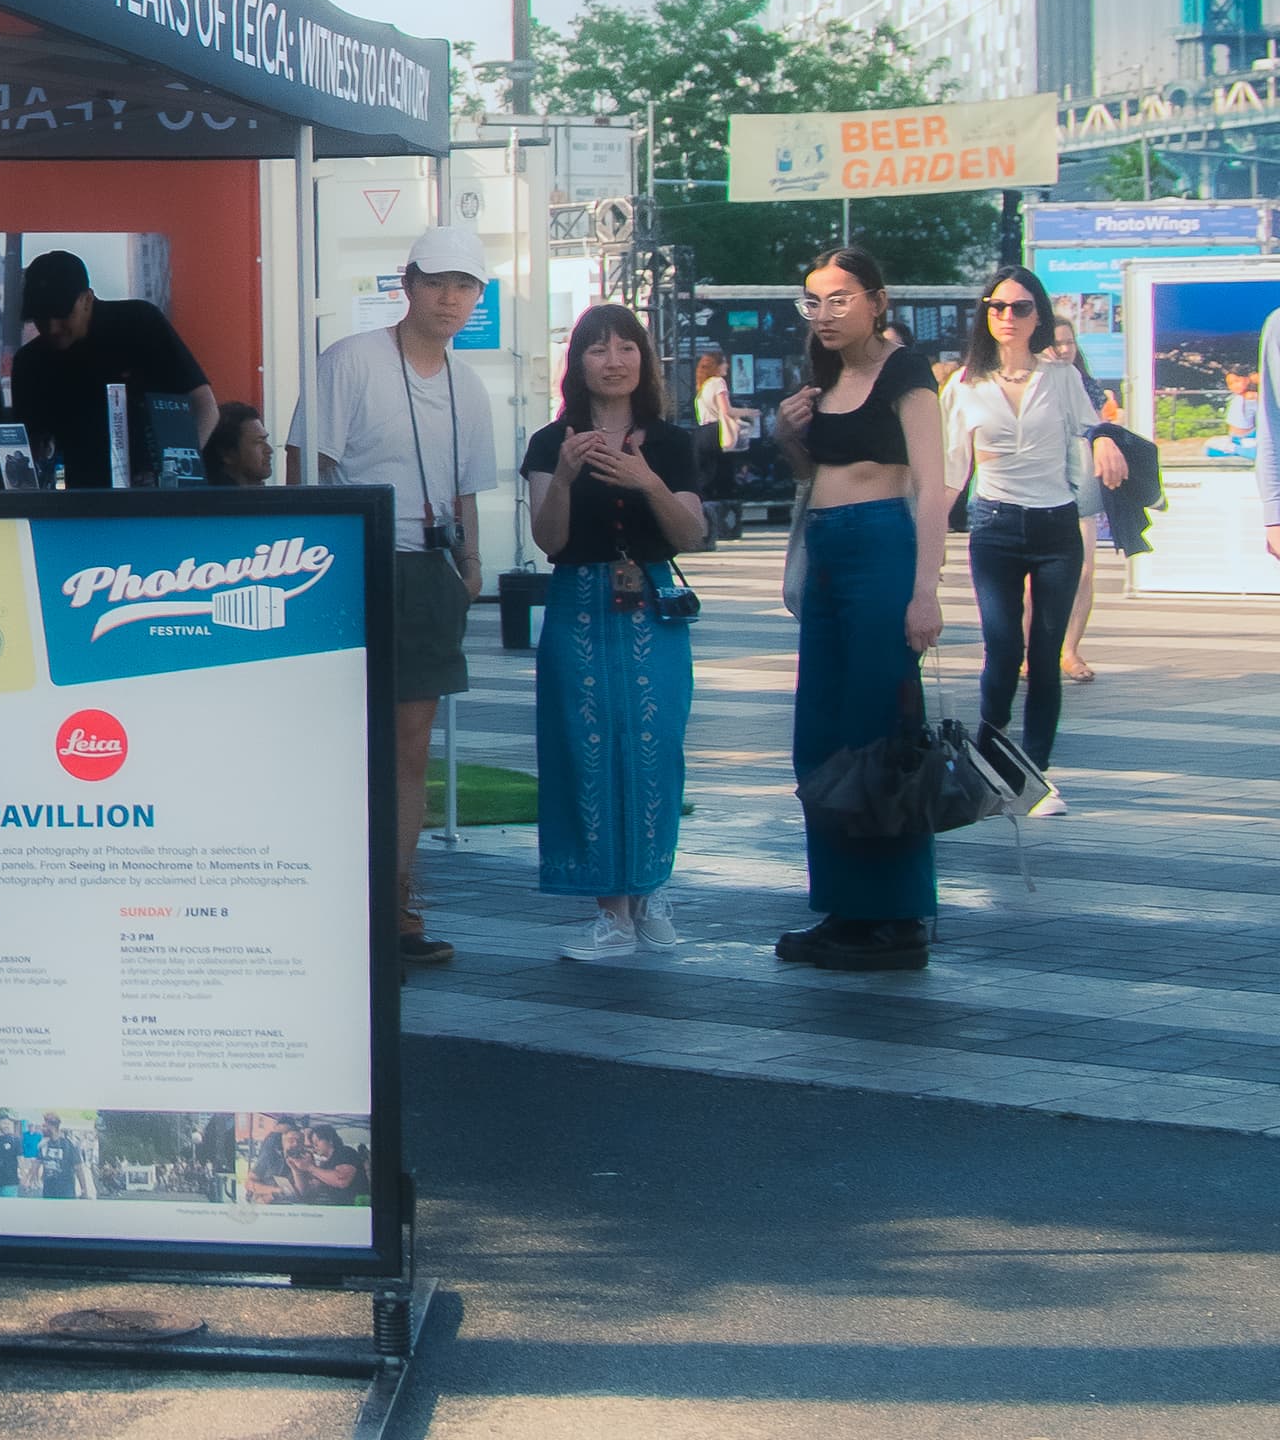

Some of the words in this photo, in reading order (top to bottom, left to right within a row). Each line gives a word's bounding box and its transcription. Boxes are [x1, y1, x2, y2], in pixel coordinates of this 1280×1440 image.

[298, 16, 360, 103] WITNESS
[360, 43, 377, 107] TO
[377, 50, 388, 106] A
[386, 47, 431, 122] CENTURY
[840, 115, 949, 153] BEER
[841, 144, 1016, 190] GARDEN
[1095, 216, 1201, 234] PhotoWings
[1049, 260, 1108, 273] Education
[61, 536, 335, 608] Photoville
[149, 624, 212, 637] FESTIVAL
[58, 728, 123, 758] Leica
[25, 845, 90, 857] photography
[91, 845, 102, 855] at
[103, 845, 155, 855] Photoville
[157, 845, 198, 857] through
[209, 845, 257, 855] selection
[258, 846, 270, 855] of
[0, 860, 37, 872] panels.
[39, 860, 66, 870] From
[68, 860, 106, 872] Seeing
[121, 860, 194, 870] Monochrome
[195, 860, 207, 870] to
[208, 860, 261, 870] Moments
[276, 860, 312, 871] Focus,
[57, 875, 77, 885] and
[78, 875, 127, 887] guidance
[128, 875, 142, 887] by
[143, 876, 197, 885] acclaimed
[199, 876, 227, 885] Leica
[229, 876, 309, 888] photographers.
[119, 907, 173, 917] SUNDAY
[185, 907, 218, 917] JUNE
[220, 907, 229, 917] 8
[120, 933, 137, 941] 2-3
[138, 933, 155, 941] PM
[120, 946, 166, 954] MOMENTS
[167, 946, 178, 954] IN
[179, 946, 211, 954] FOCUS
[212, 946, 244, 954] PHOTO
[245, 946, 273, 954] WALK
[121, 1015, 139, 1023] 5-6
[140, 1015, 157, 1024] PM
[24, 1026, 50, 1034] WALK
[148, 1029, 185, 1037] WOMEN
[186, 1029, 211, 1037] FOTO
